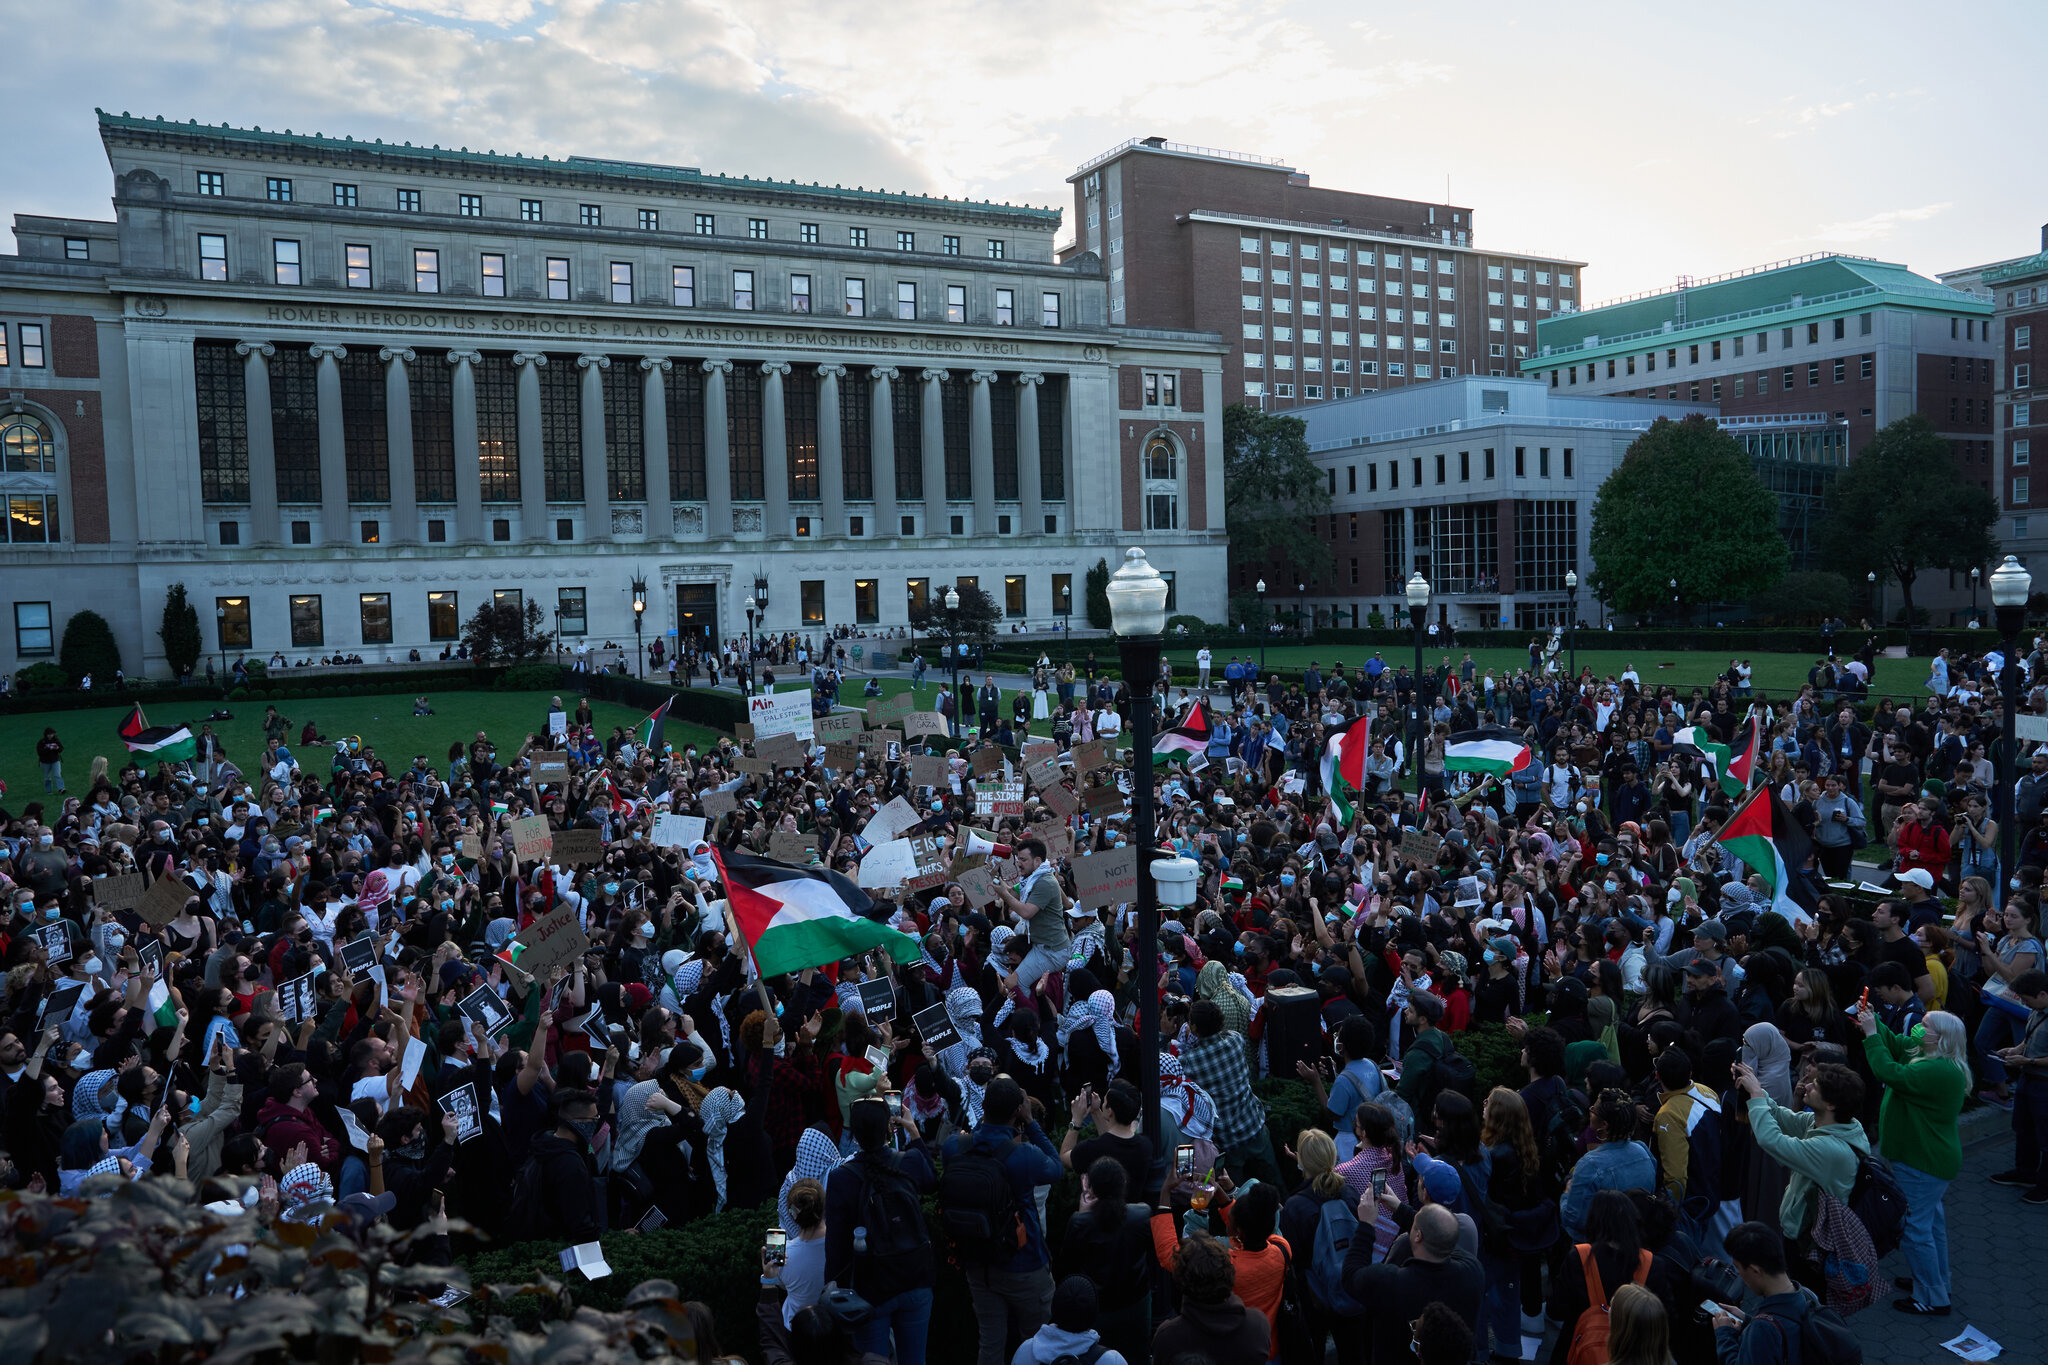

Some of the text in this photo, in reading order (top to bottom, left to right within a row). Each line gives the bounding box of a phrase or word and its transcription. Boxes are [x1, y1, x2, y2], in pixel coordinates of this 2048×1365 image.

[267, 307, 1023, 356] HOMER HERODOTUS SOPHOCLES PLATO ARISTOTLE DEMOSTHENES CICERO VERGIL
[752, 698, 774, 711] Min
[876, 702, 896, 712] END
[764, 711, 801, 723] PALESTINE
[910, 713, 930, 722] FREE
[820, 717, 850, 731] FREE
[917, 720, 938, 729] GAZA
[828, 745, 857, 760] FREE
[1030, 764, 1044, 775] STOP
[1004, 783, 1015, 791] IS
[976, 791, 1024, 801] THE SIDE OF
[976, 802, 1024, 815] THE OPPRESSED
[525, 827, 542, 840] FOR
[517, 835, 553, 857] PALESTINE
[923, 836, 937, 852] IS
[1104, 863, 1130, 879] NOT
[962, 873, 980, 890] NO
[1080, 882, 1111, 897] HUMAN
[536, 913, 573, 943] Justice
[351, 960, 374, 973] PEOPLE
[866, 1002, 892, 1014] PEOPLE
[926, 1028, 952, 1043] PEOPLE
